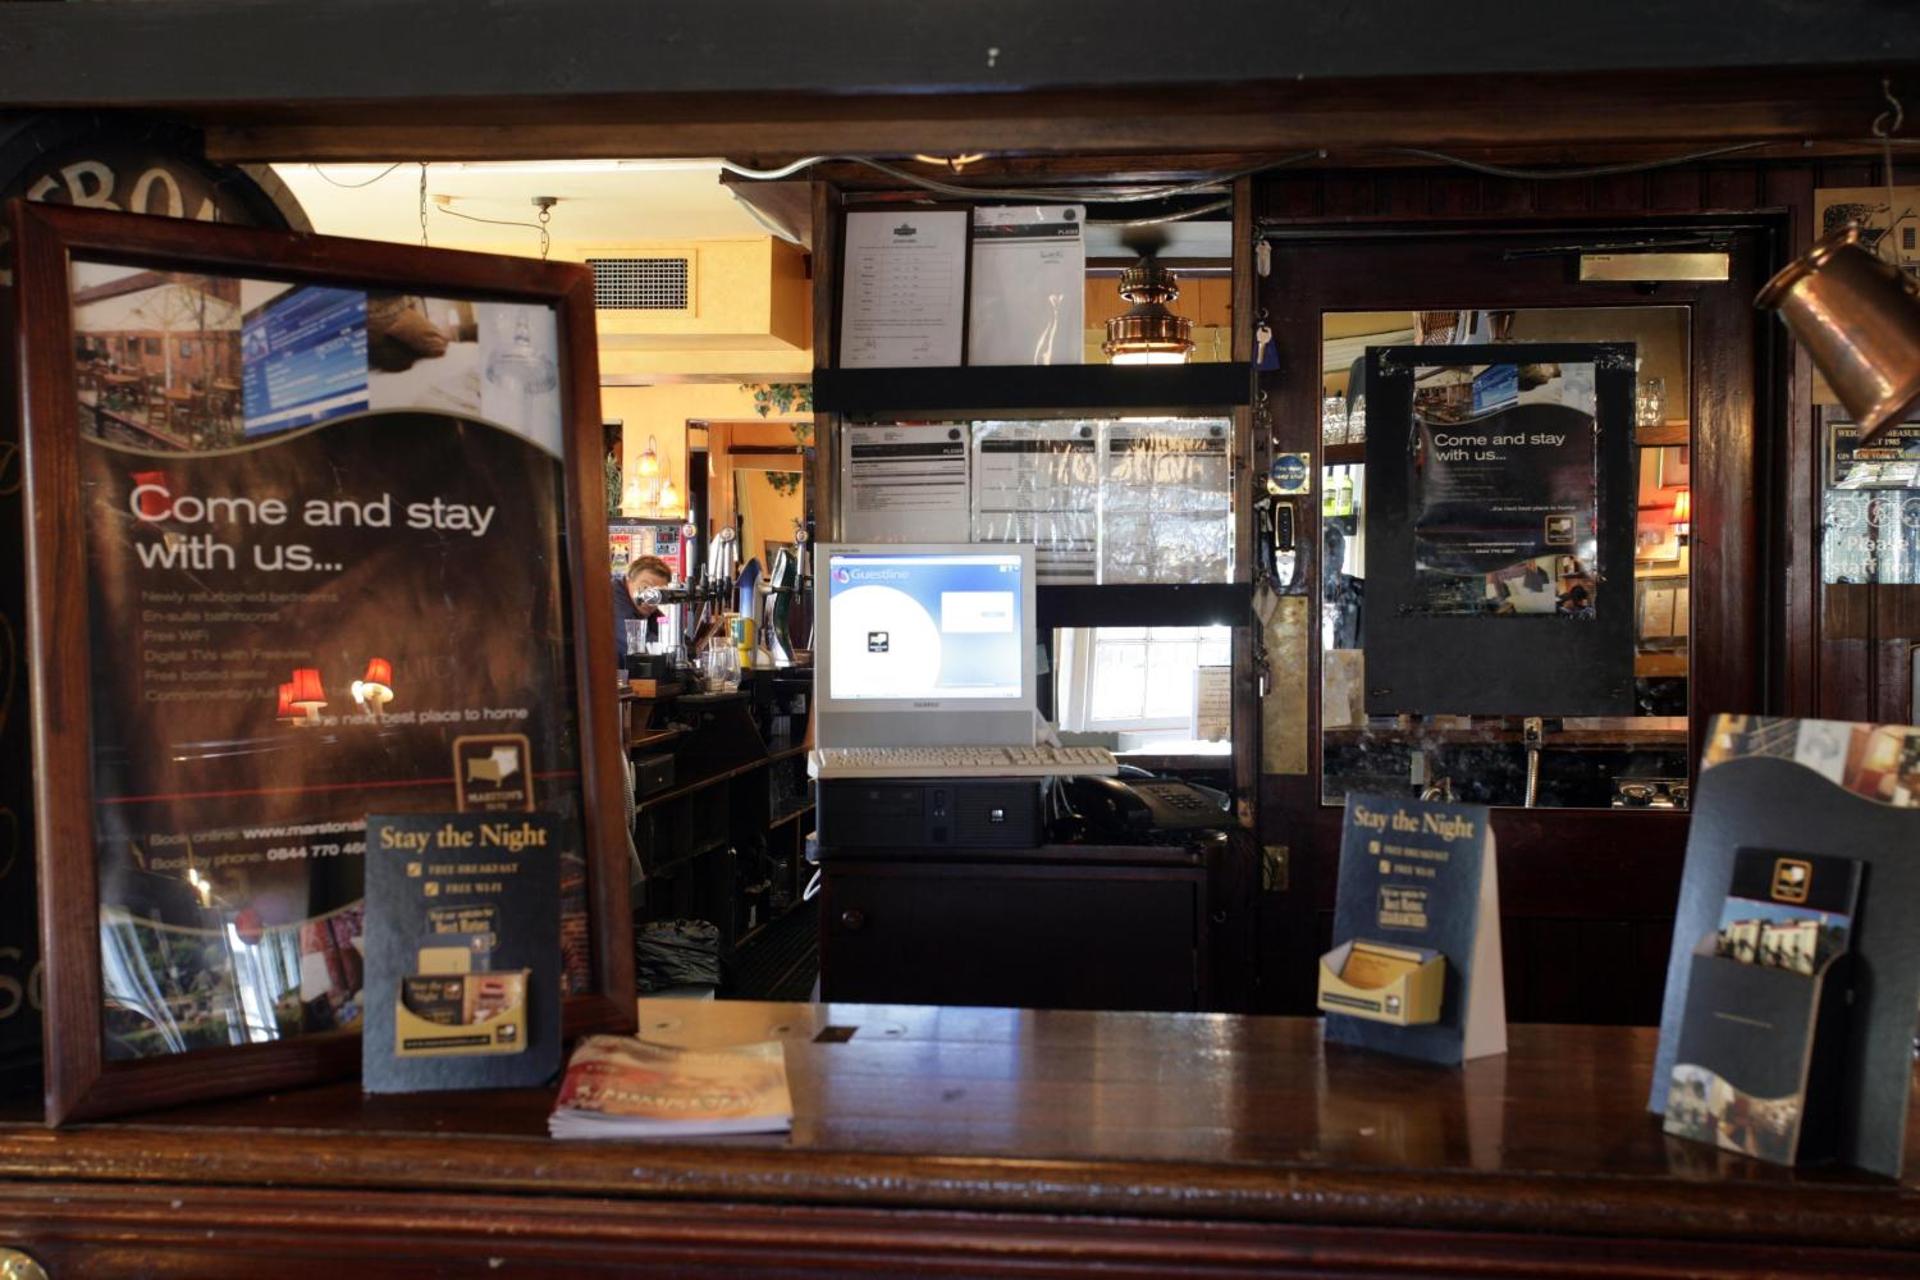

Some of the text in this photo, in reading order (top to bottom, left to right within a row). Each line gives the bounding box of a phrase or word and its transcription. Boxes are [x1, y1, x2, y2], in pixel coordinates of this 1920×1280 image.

[1434, 433, 1566, 447] Come and stay
[1435, 449, 1470, 461] with
[129, 483, 495, 537] Come and stay
[135, 533, 344, 572] with us...
[1847, 535, 1910, 551] Please
[850, 567, 909, 581] Guestline
[418, 708, 461, 726] place
[464, 708, 482, 721] to
[482, 706, 529, 721] home
[1353, 804, 1475, 841] Stay the Night
[380, 822, 548, 853] Stay the Night
